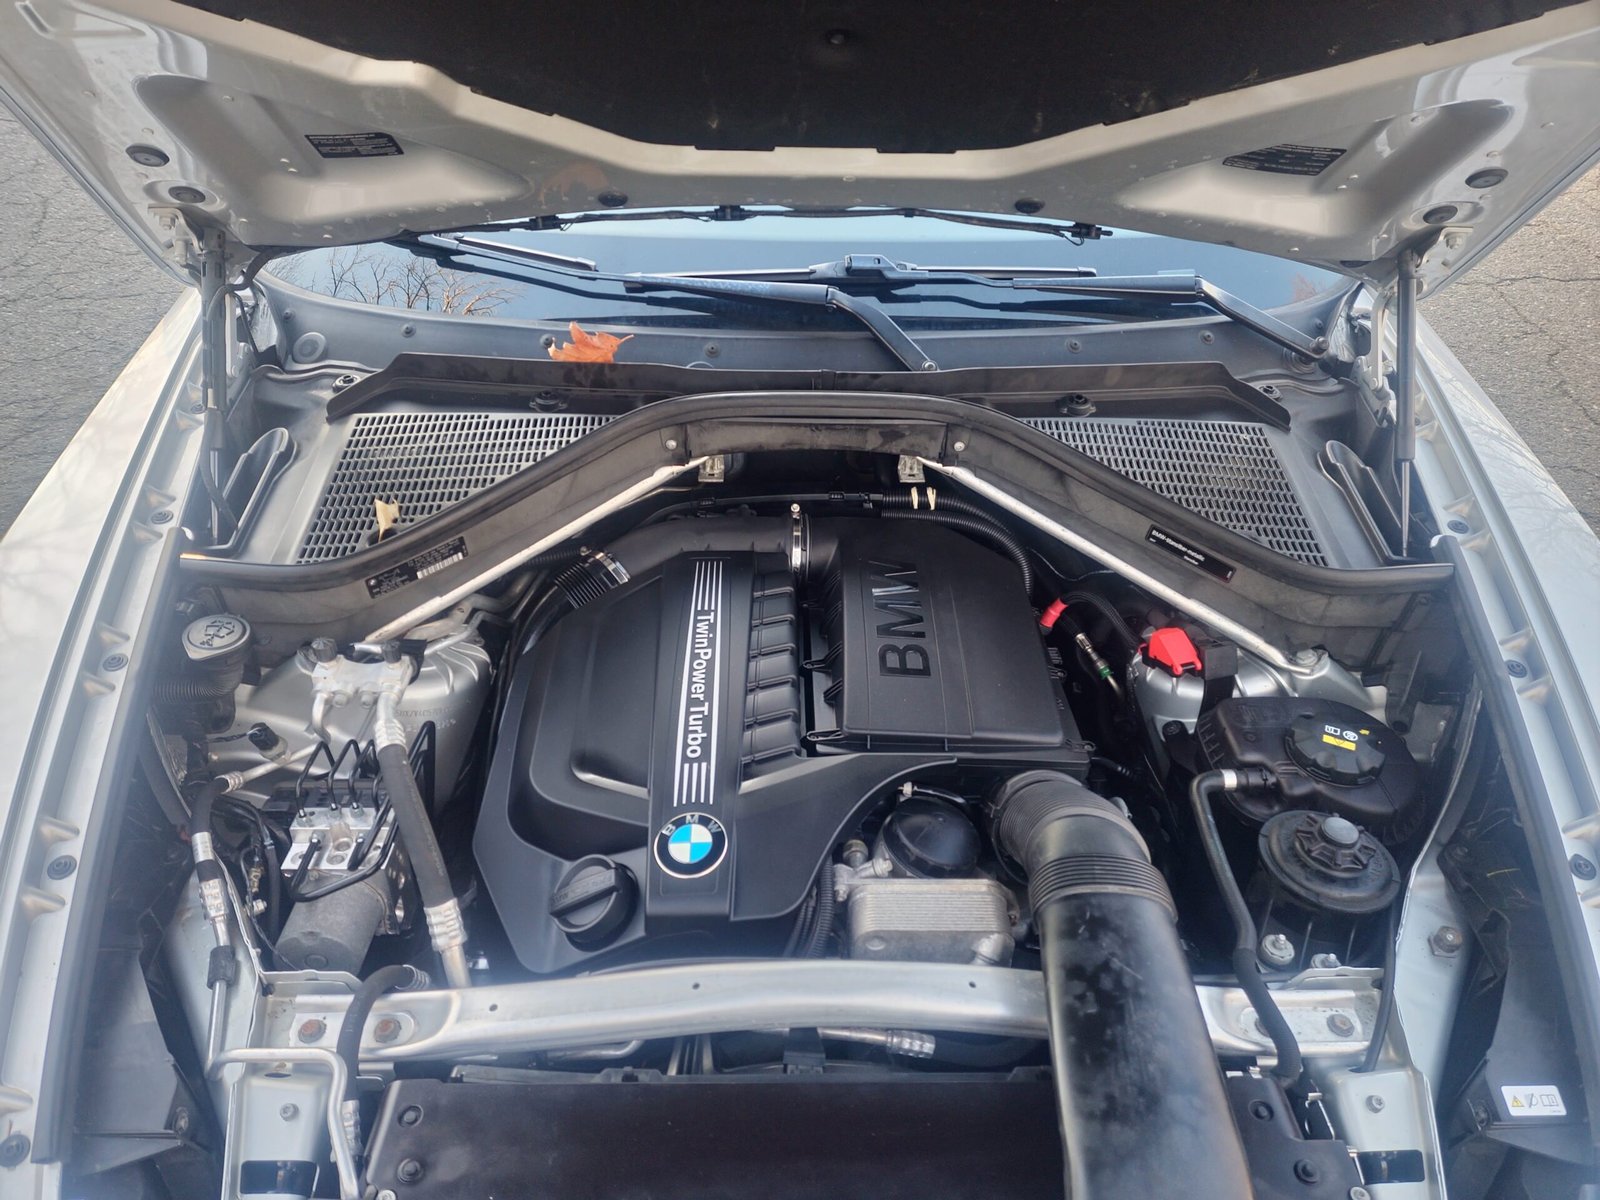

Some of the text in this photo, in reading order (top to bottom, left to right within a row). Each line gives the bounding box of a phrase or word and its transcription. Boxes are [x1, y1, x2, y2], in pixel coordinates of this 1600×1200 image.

[868, 560, 931, 678] BMW
[686, 611, 714, 759] TwinPower Turbo
[661, 814, 722, 836] BMW
